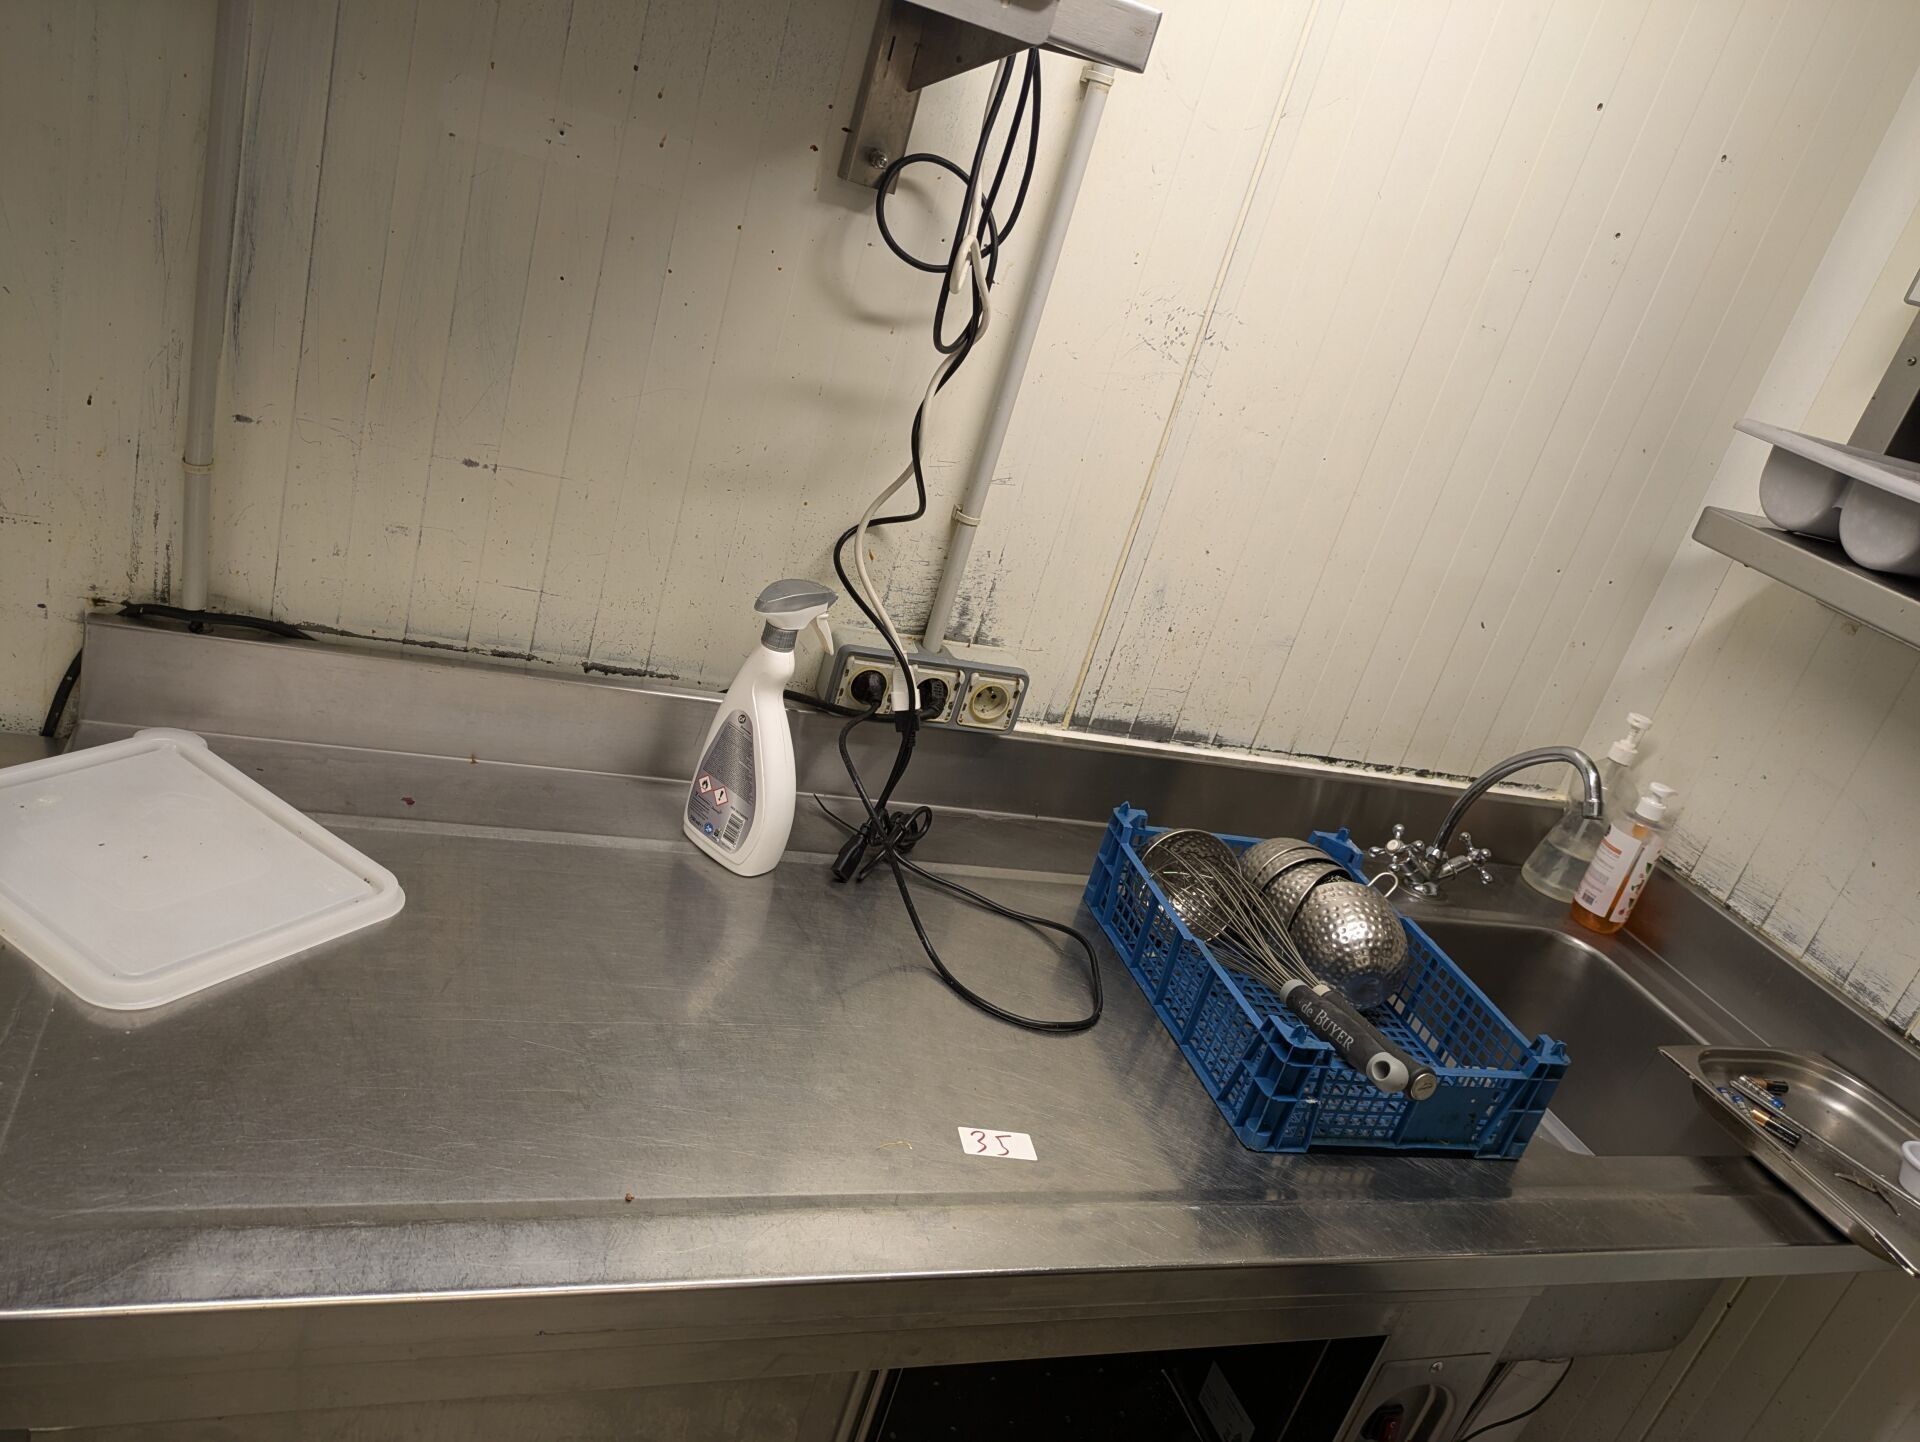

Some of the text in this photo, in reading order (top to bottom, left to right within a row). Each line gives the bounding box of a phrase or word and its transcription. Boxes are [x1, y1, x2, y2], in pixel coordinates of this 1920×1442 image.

[1301, 1001, 1355, 1050] de BUYER
[970, 1130, 1012, 1156] 35
